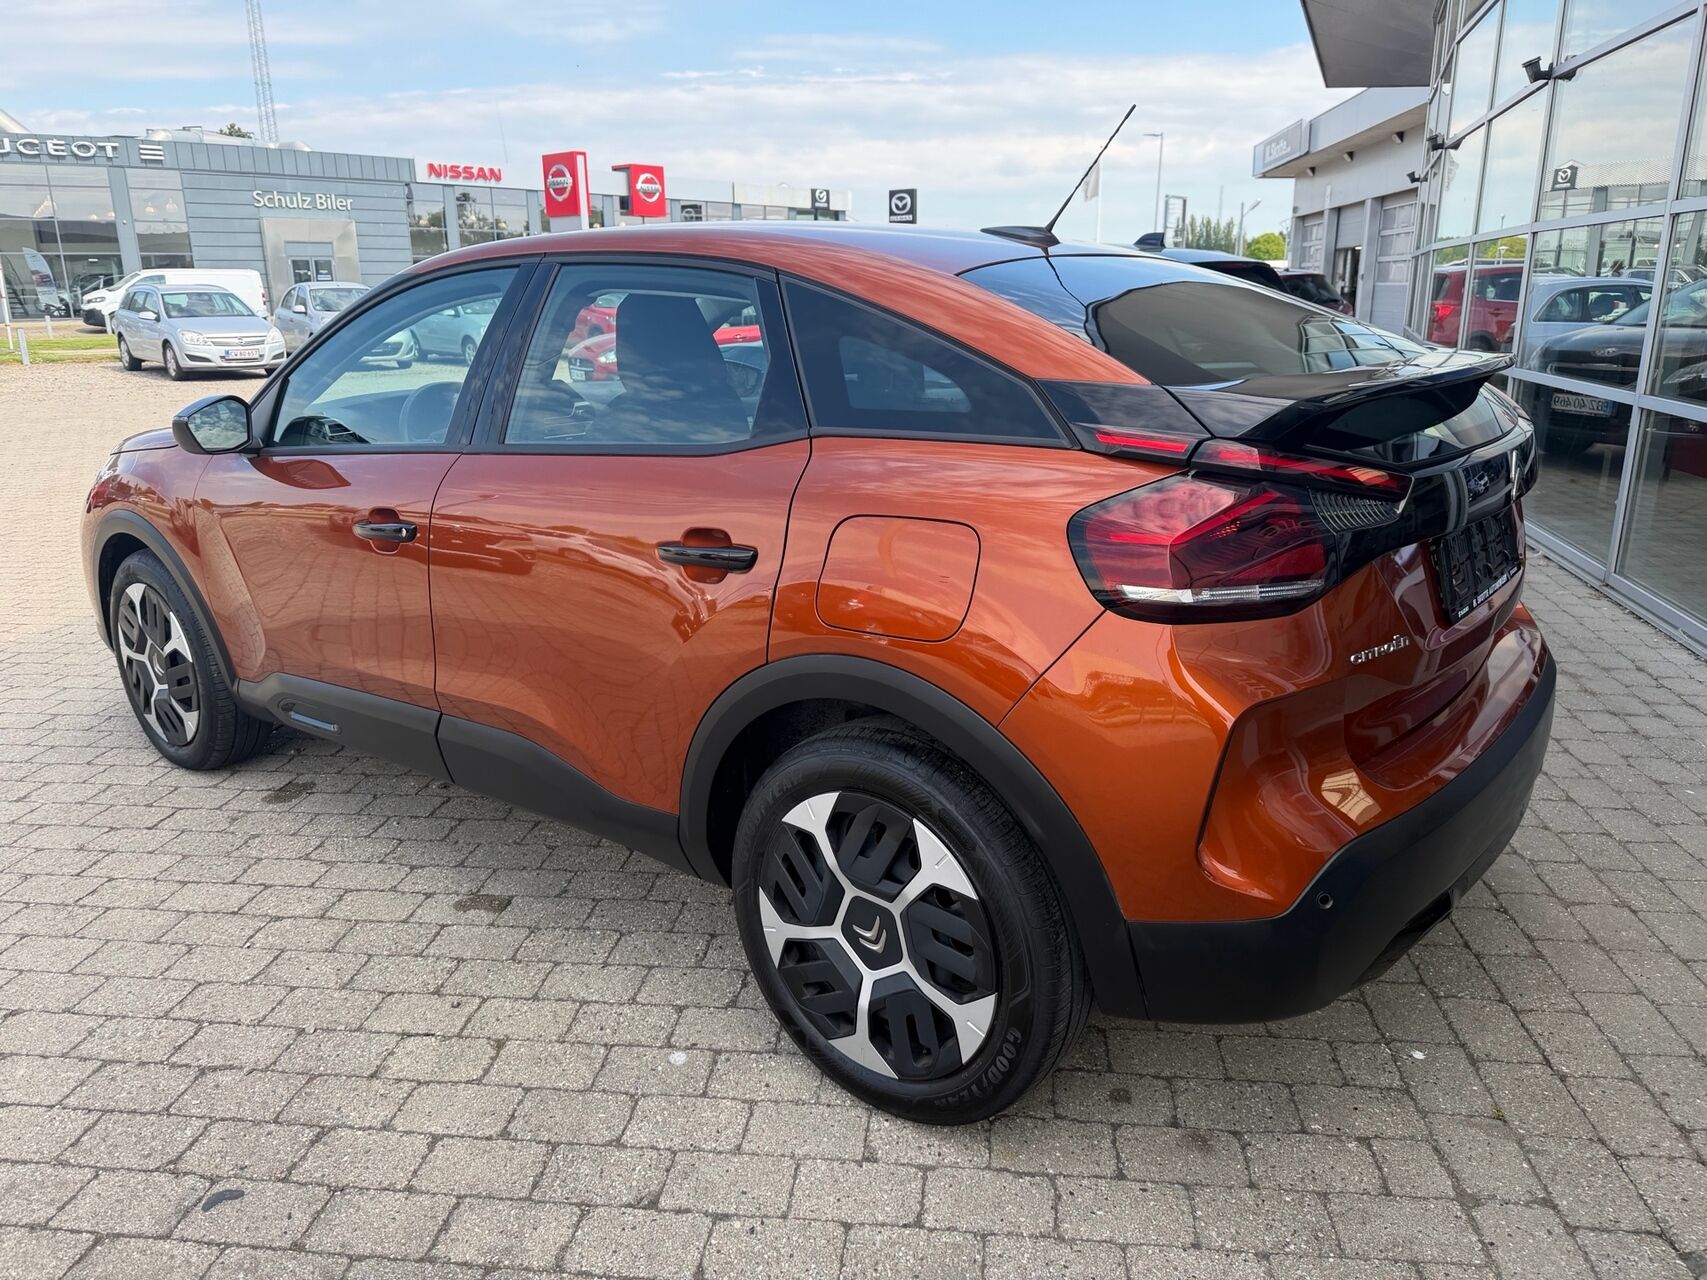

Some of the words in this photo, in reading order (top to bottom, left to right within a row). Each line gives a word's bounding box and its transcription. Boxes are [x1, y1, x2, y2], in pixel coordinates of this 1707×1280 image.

[427, 163, 502, 182] NISSAN
[252, 190, 311, 210] Schulz
[315, 192, 353, 212] Biler
